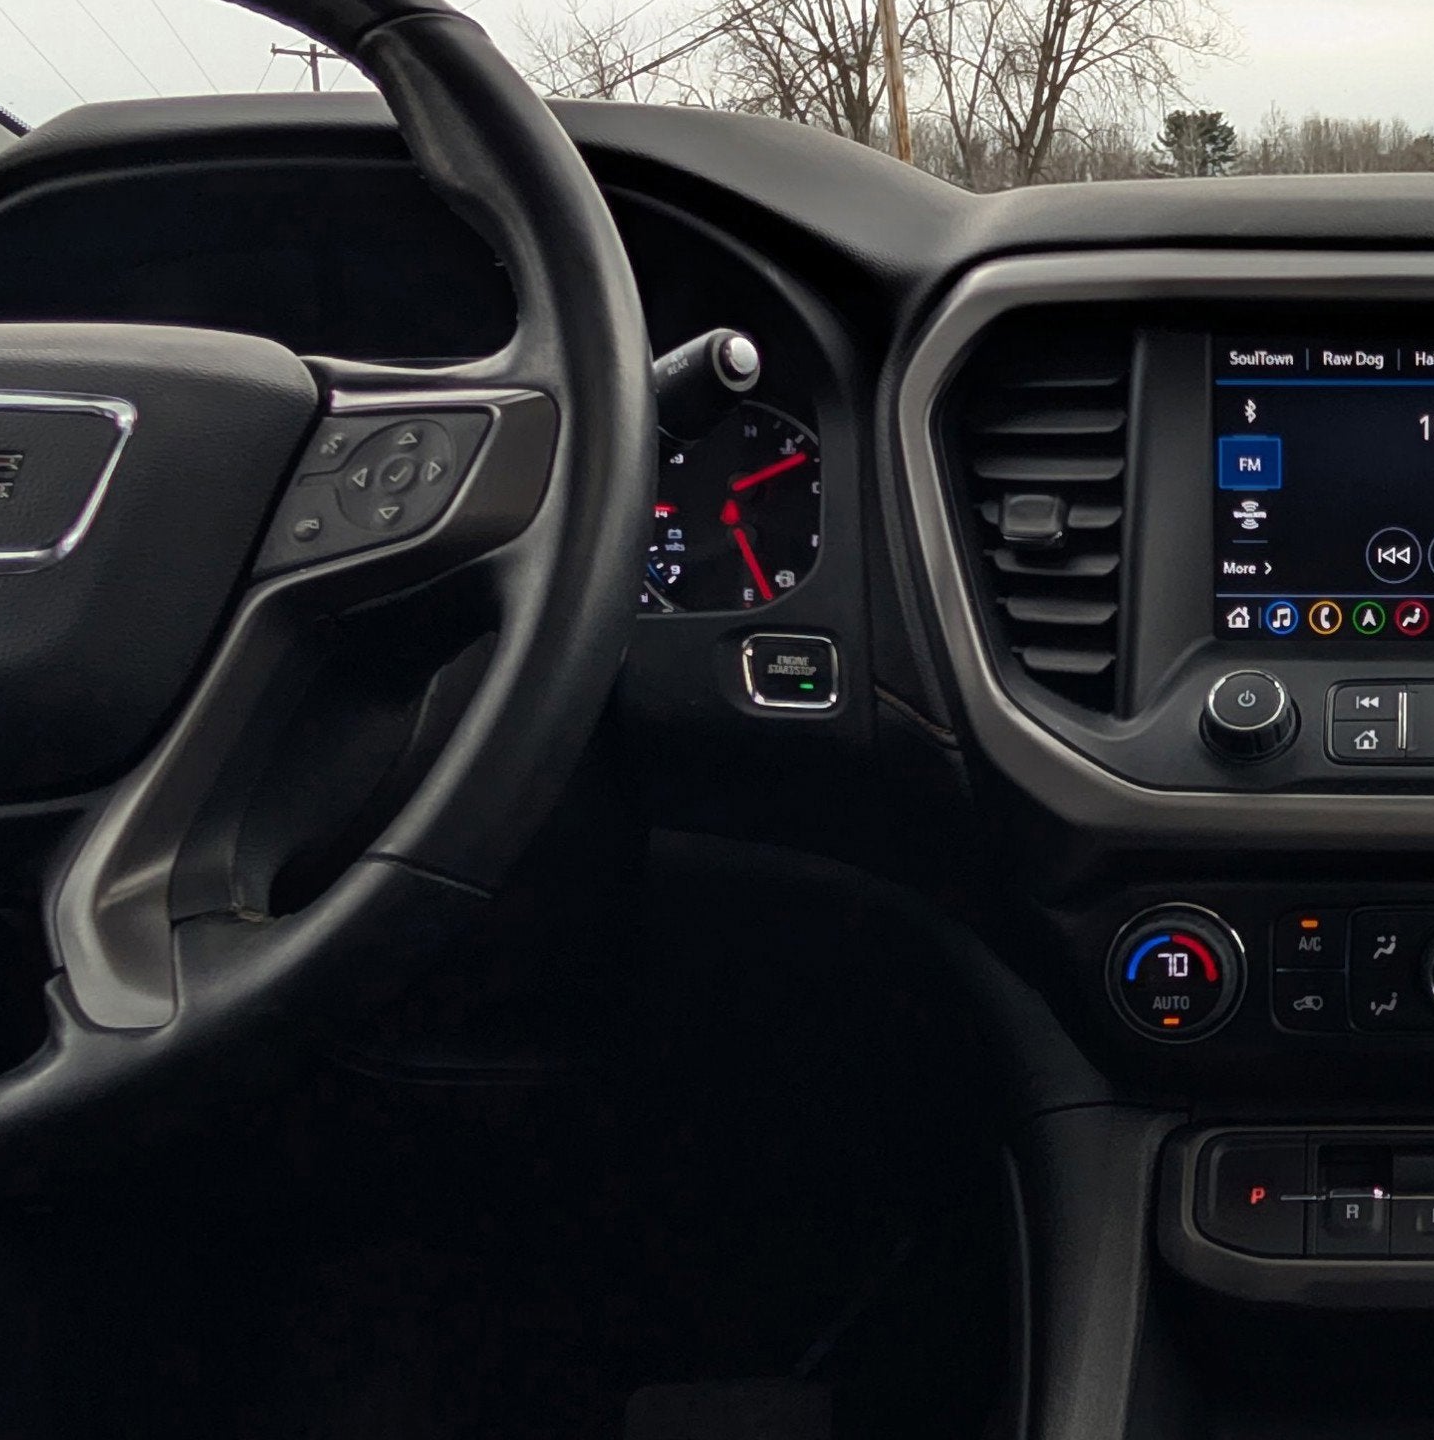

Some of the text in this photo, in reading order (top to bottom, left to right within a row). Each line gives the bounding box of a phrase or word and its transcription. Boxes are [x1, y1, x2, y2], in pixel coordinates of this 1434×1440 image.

[1229, 350, 1294, 366] SoulTown
[1323, 351, 1352, 366] Raw
[1356, 351, 1384, 370] Dog
[1239, 457, 1261, 472] FM
[1223, 562, 1256, 575] More
[744, 589, 755, 602] E
[1298, 935, 1322, 953] A/C
[1158, 953, 1188, 978] 70
[1152, 997, 1190, 1010] AUTO
[1250, 1188, 1266, 1204] P
[1346, 1204, 1359, 1218] R
